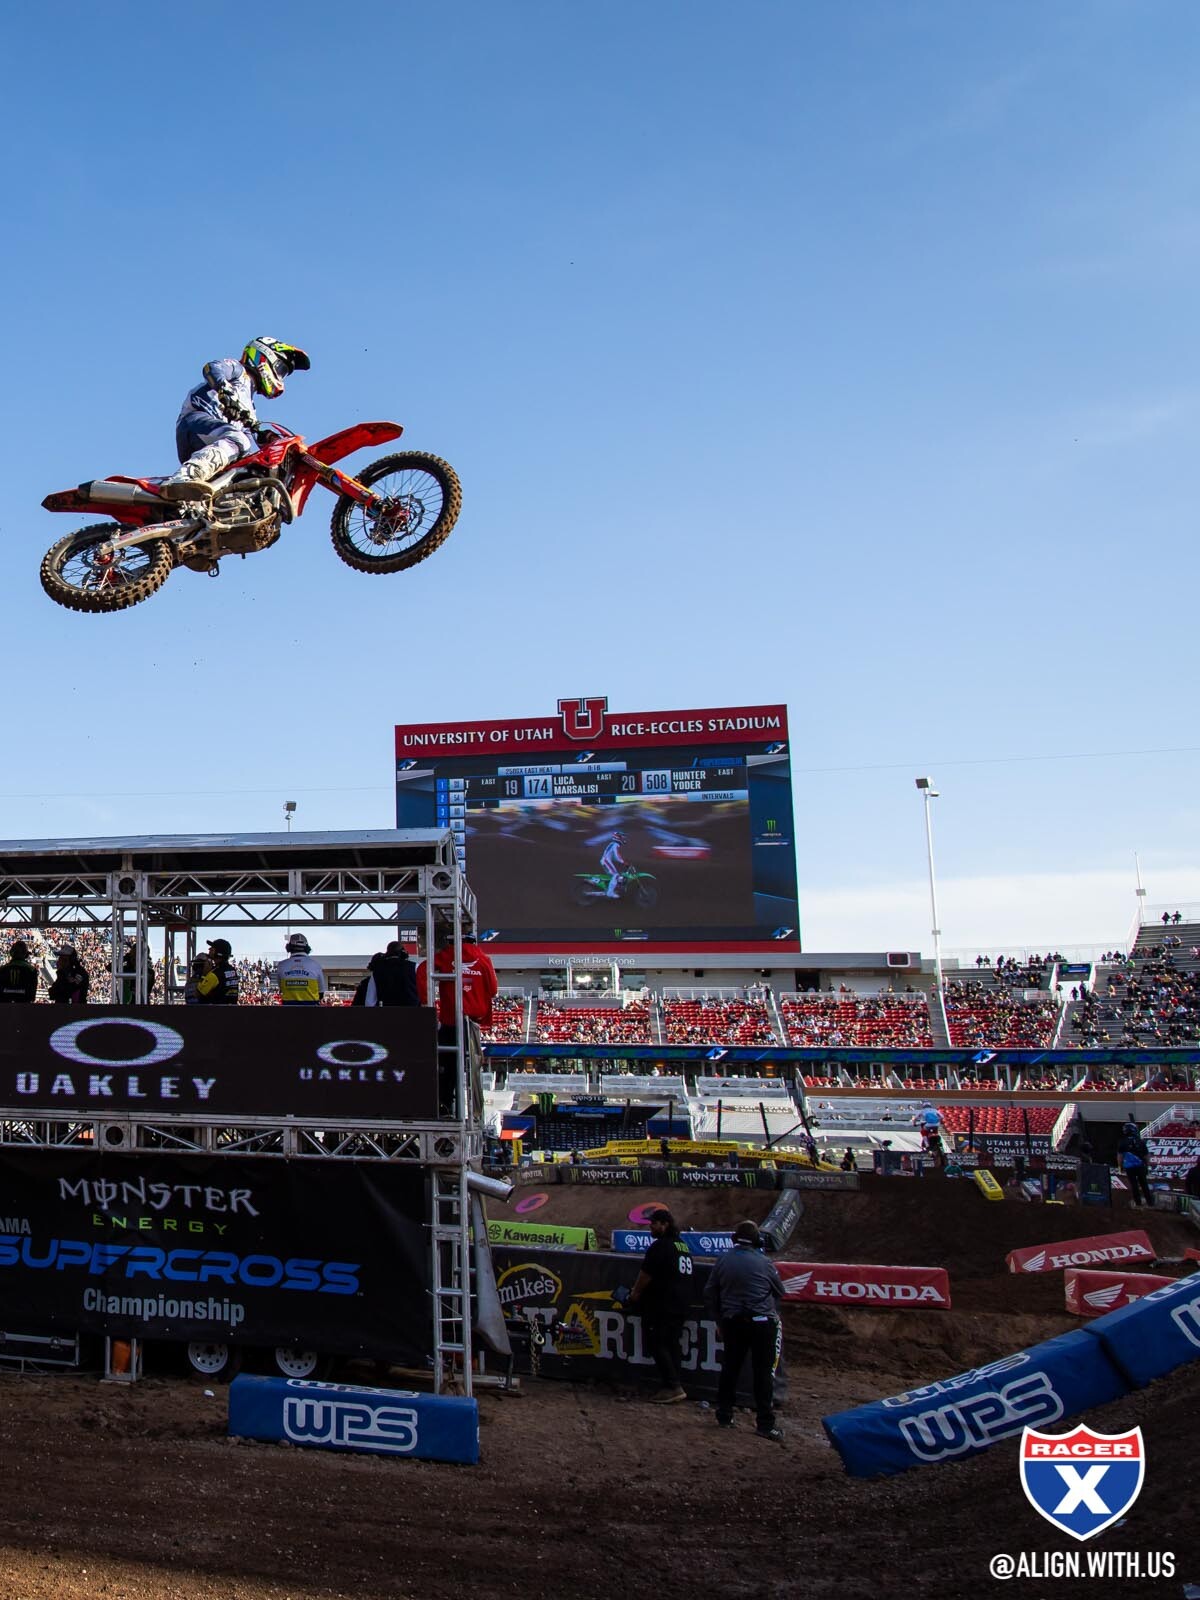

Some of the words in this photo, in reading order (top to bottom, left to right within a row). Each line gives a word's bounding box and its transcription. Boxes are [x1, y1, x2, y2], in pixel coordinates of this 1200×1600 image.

[558, 697, 608, 740] U
[611, 721, 703, 736] RICE-ECCLES
[708, 716, 781, 731] STADIUM
[403, 731, 486, 746] UNIVERSITY
[490, 730, 508, 742] OF
[514, 728, 553, 741] UTAH
[505, 780, 518, 796] 19
[528, 778, 548, 794] 174
[553, 776, 575, 786] LUCA
[554, 784, 599, 795] MARSALISI
[621, 775, 636, 791] 20
[646, 773, 667, 789] 508
[672, 770, 706, 781] HUNTER
[673, 780, 702, 790] YODER
[549, 957, 566, 965] Ken
[300, 1067, 406, 1082] OAKLEY
[16, 1072, 217, 1099] OAKLEY
[986, 1139, 1011, 1147] UTAH
[1014, 1140, 1049, 1148] SPRTS
[1157, 1138, 1184, 1146] ROCKY
[582, 1170, 629, 1180] MONSTER
[682, 1172, 740, 1183] MONSTER
[801, 1174, 843, 1183] MONSTER
[57, 1176, 260, 1217] MONSTER
[93, 1214, 227, 1235] ENERGY
[504, 1228, 565, 1245] Kawasaki
[679, 1255, 692, 1274] 69
[1050, 1243, 1151, 1268] HONDA
[814, 1280, 945, 1302] HONDA
[83, 1287, 246, 1326] Championship
[283, 1397, 418, 1451] WPS
[899, 1371, 1064, 1461] WPS
